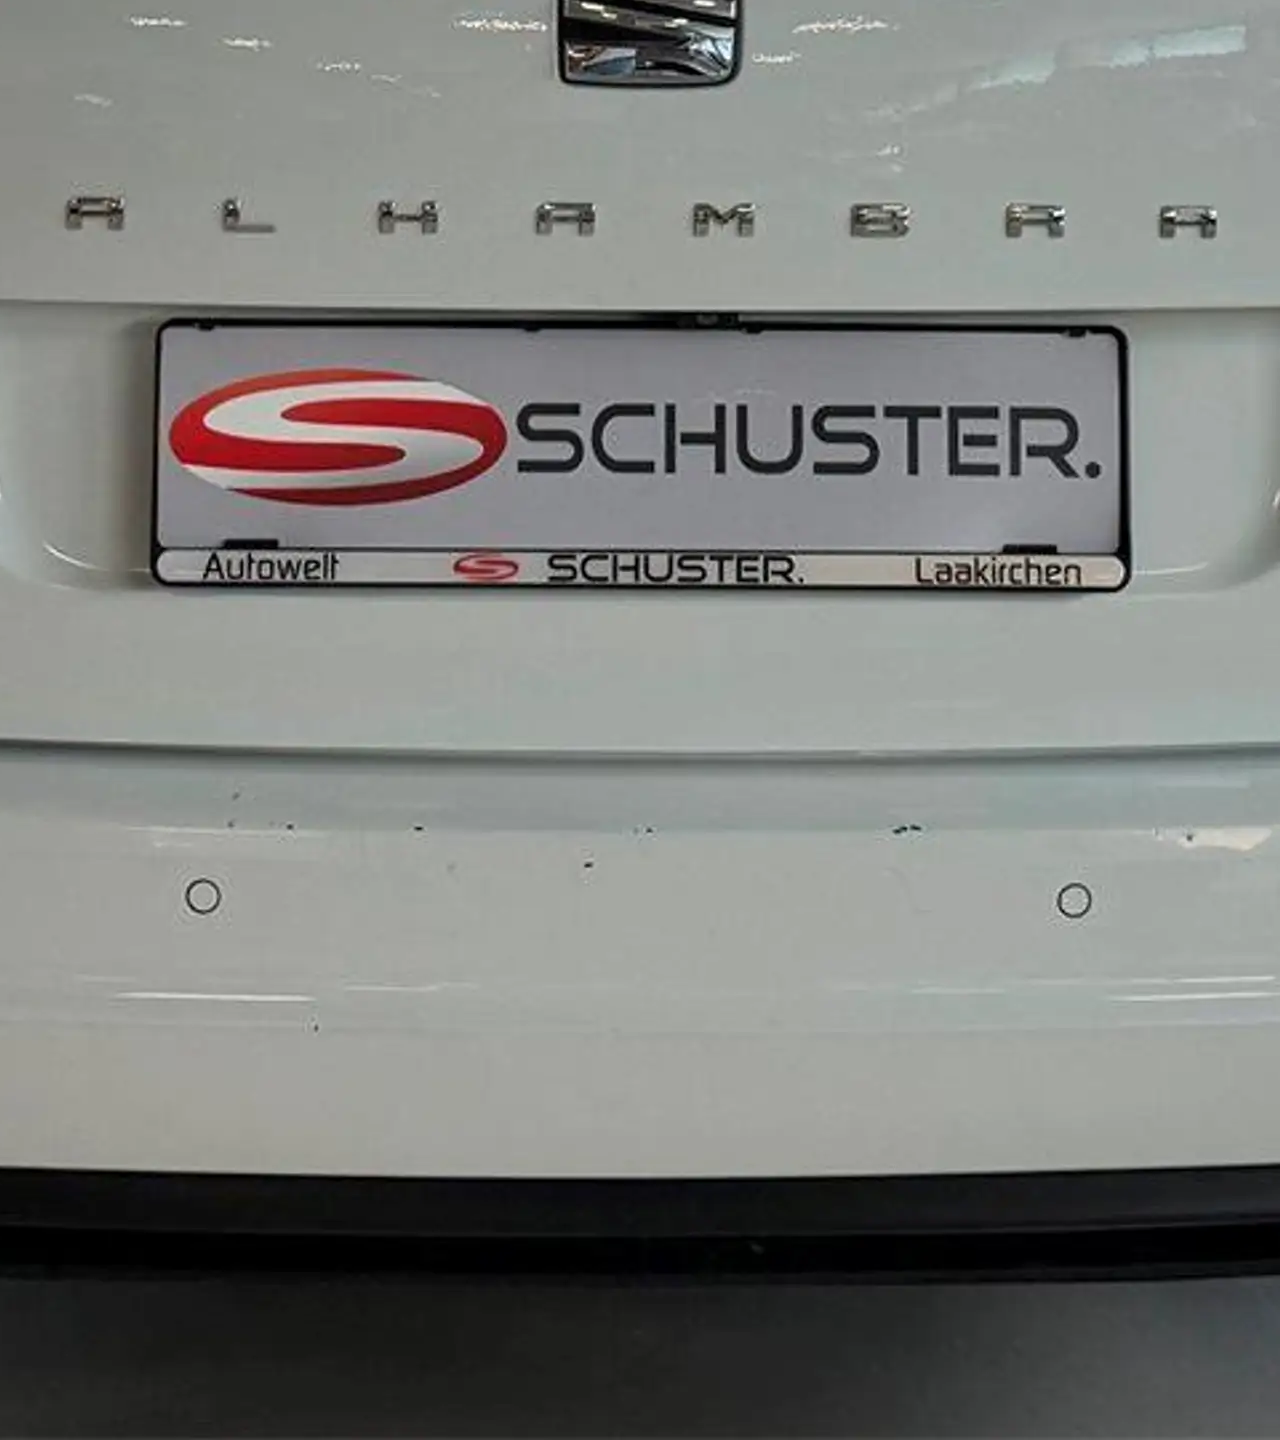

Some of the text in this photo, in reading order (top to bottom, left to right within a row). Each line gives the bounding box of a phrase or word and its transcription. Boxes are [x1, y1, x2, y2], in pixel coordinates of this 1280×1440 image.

[64, 195, 1218, 239] ALHAMBRA
[516, 402, 1102, 479] SCHUSTER.
[201, 552, 1083, 586] Autowelt SCHUSTER. Laakirchen
